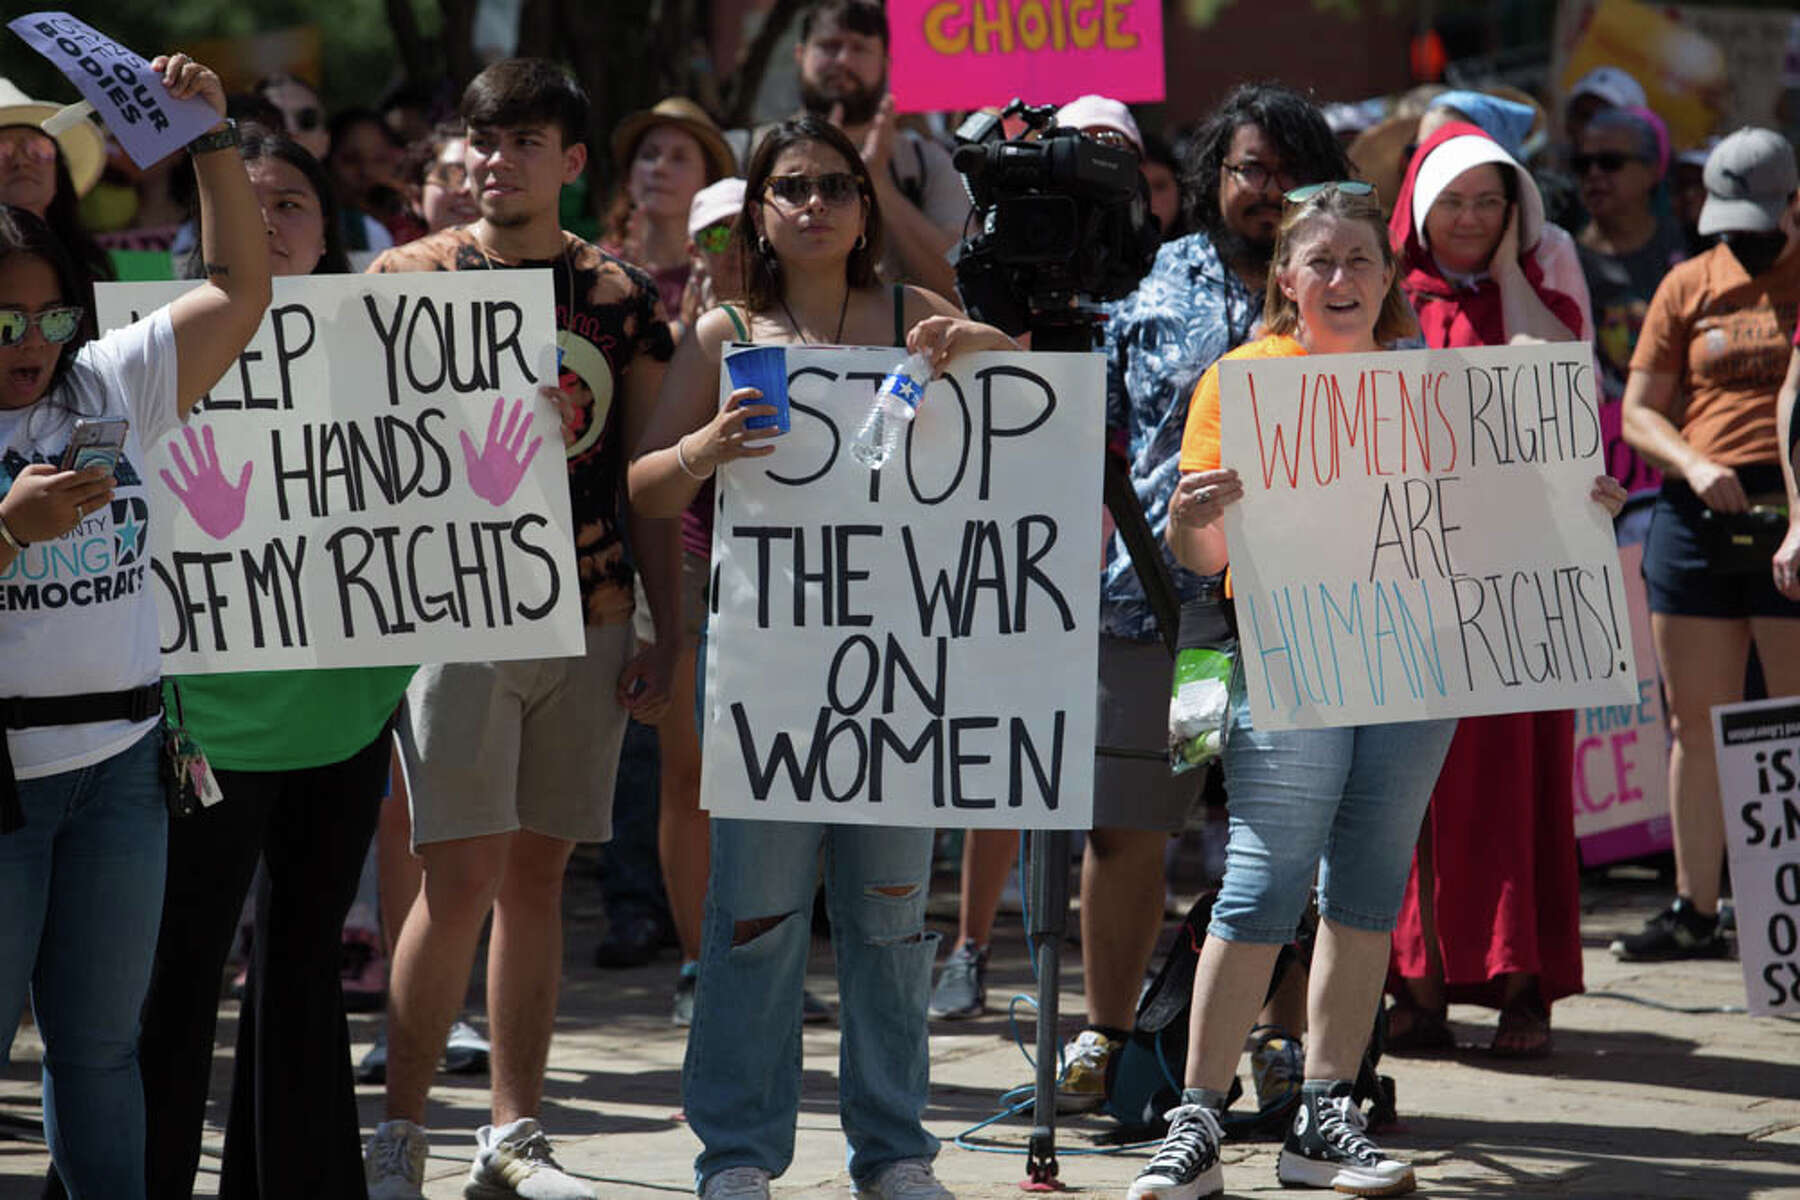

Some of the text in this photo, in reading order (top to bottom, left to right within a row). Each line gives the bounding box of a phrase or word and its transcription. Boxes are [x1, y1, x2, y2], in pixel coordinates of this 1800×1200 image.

[34, 21, 142, 125] BODIES
[924, 0, 1140, 54] CHOICE
[112, 63, 170, 134] OUR
[364, 294, 538, 405] YOUR
[272, 408, 452, 520] HANDS
[765, 365, 1057, 505] STOP
[1247, 370, 1458, 490] WOMEN'S
[1465, 361, 1600, 467] RIGHTS
[240, 535, 309, 649] MY
[326, 513, 561, 638] RIGHTS
[732, 524, 883, 629] THE
[902, 514, 1076, 639] WAR
[1369, 476, 1462, 583] ARE
[827, 633, 948, 717] ON
[1248, 565, 1628, 710] HUMAN RIGHTS!
[731, 702, 1066, 811] WOMEN
